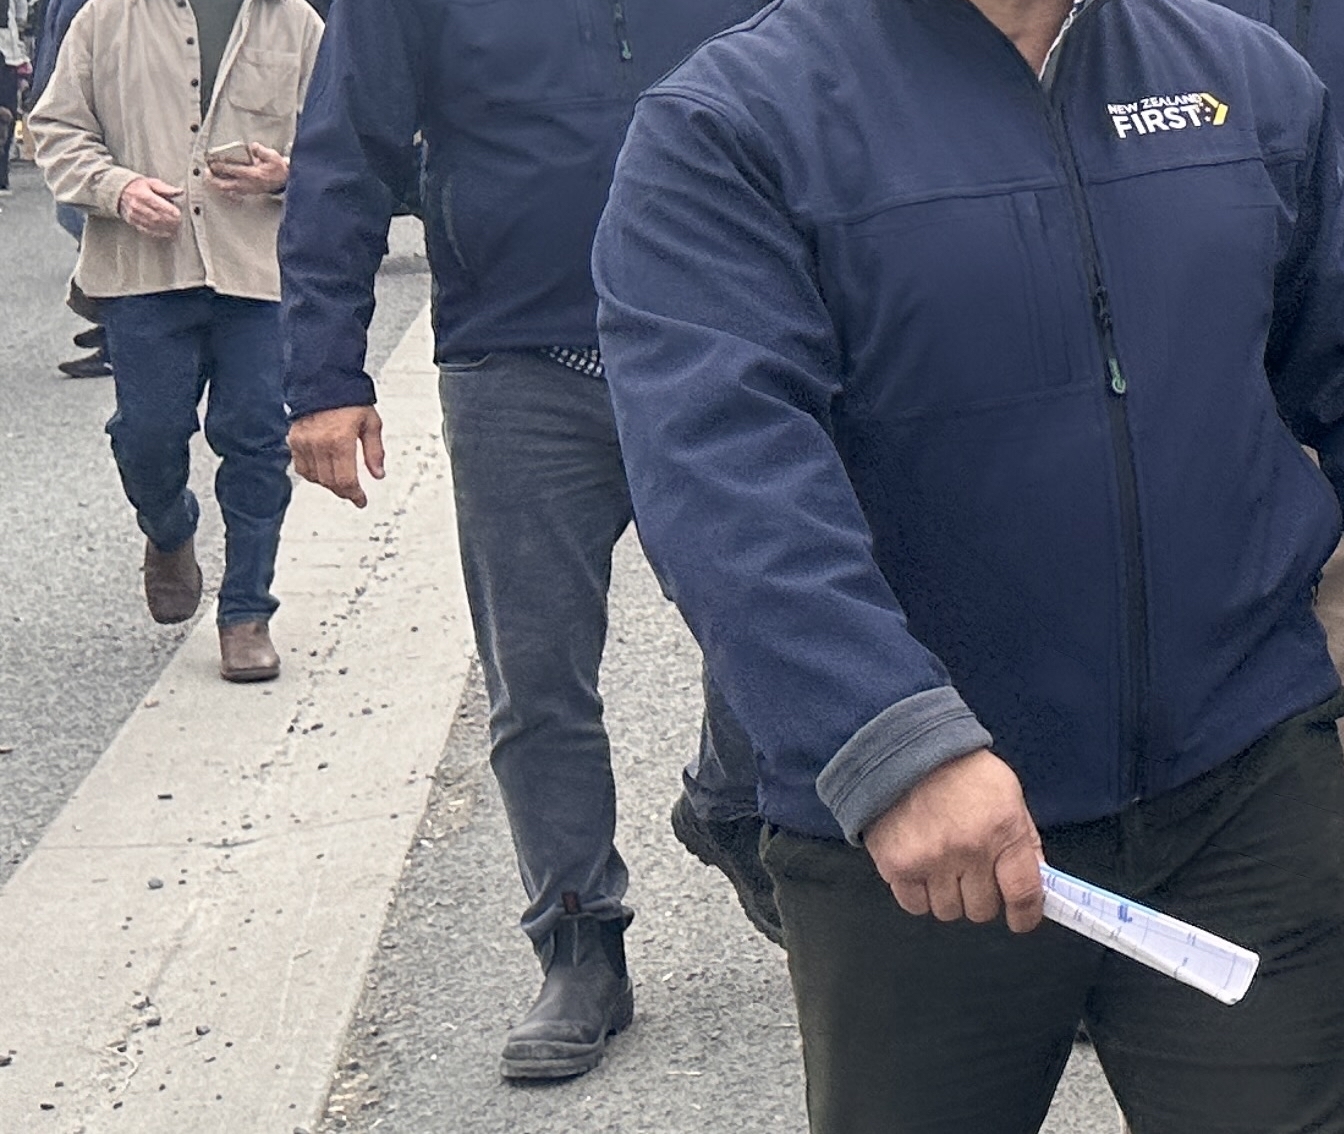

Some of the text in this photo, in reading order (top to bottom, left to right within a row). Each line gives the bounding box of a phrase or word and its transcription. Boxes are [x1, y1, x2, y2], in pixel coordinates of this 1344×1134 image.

[1107, 93, 1204, 115] NEW ZEALAND
[1111, 104, 1202, 139] FIRST
